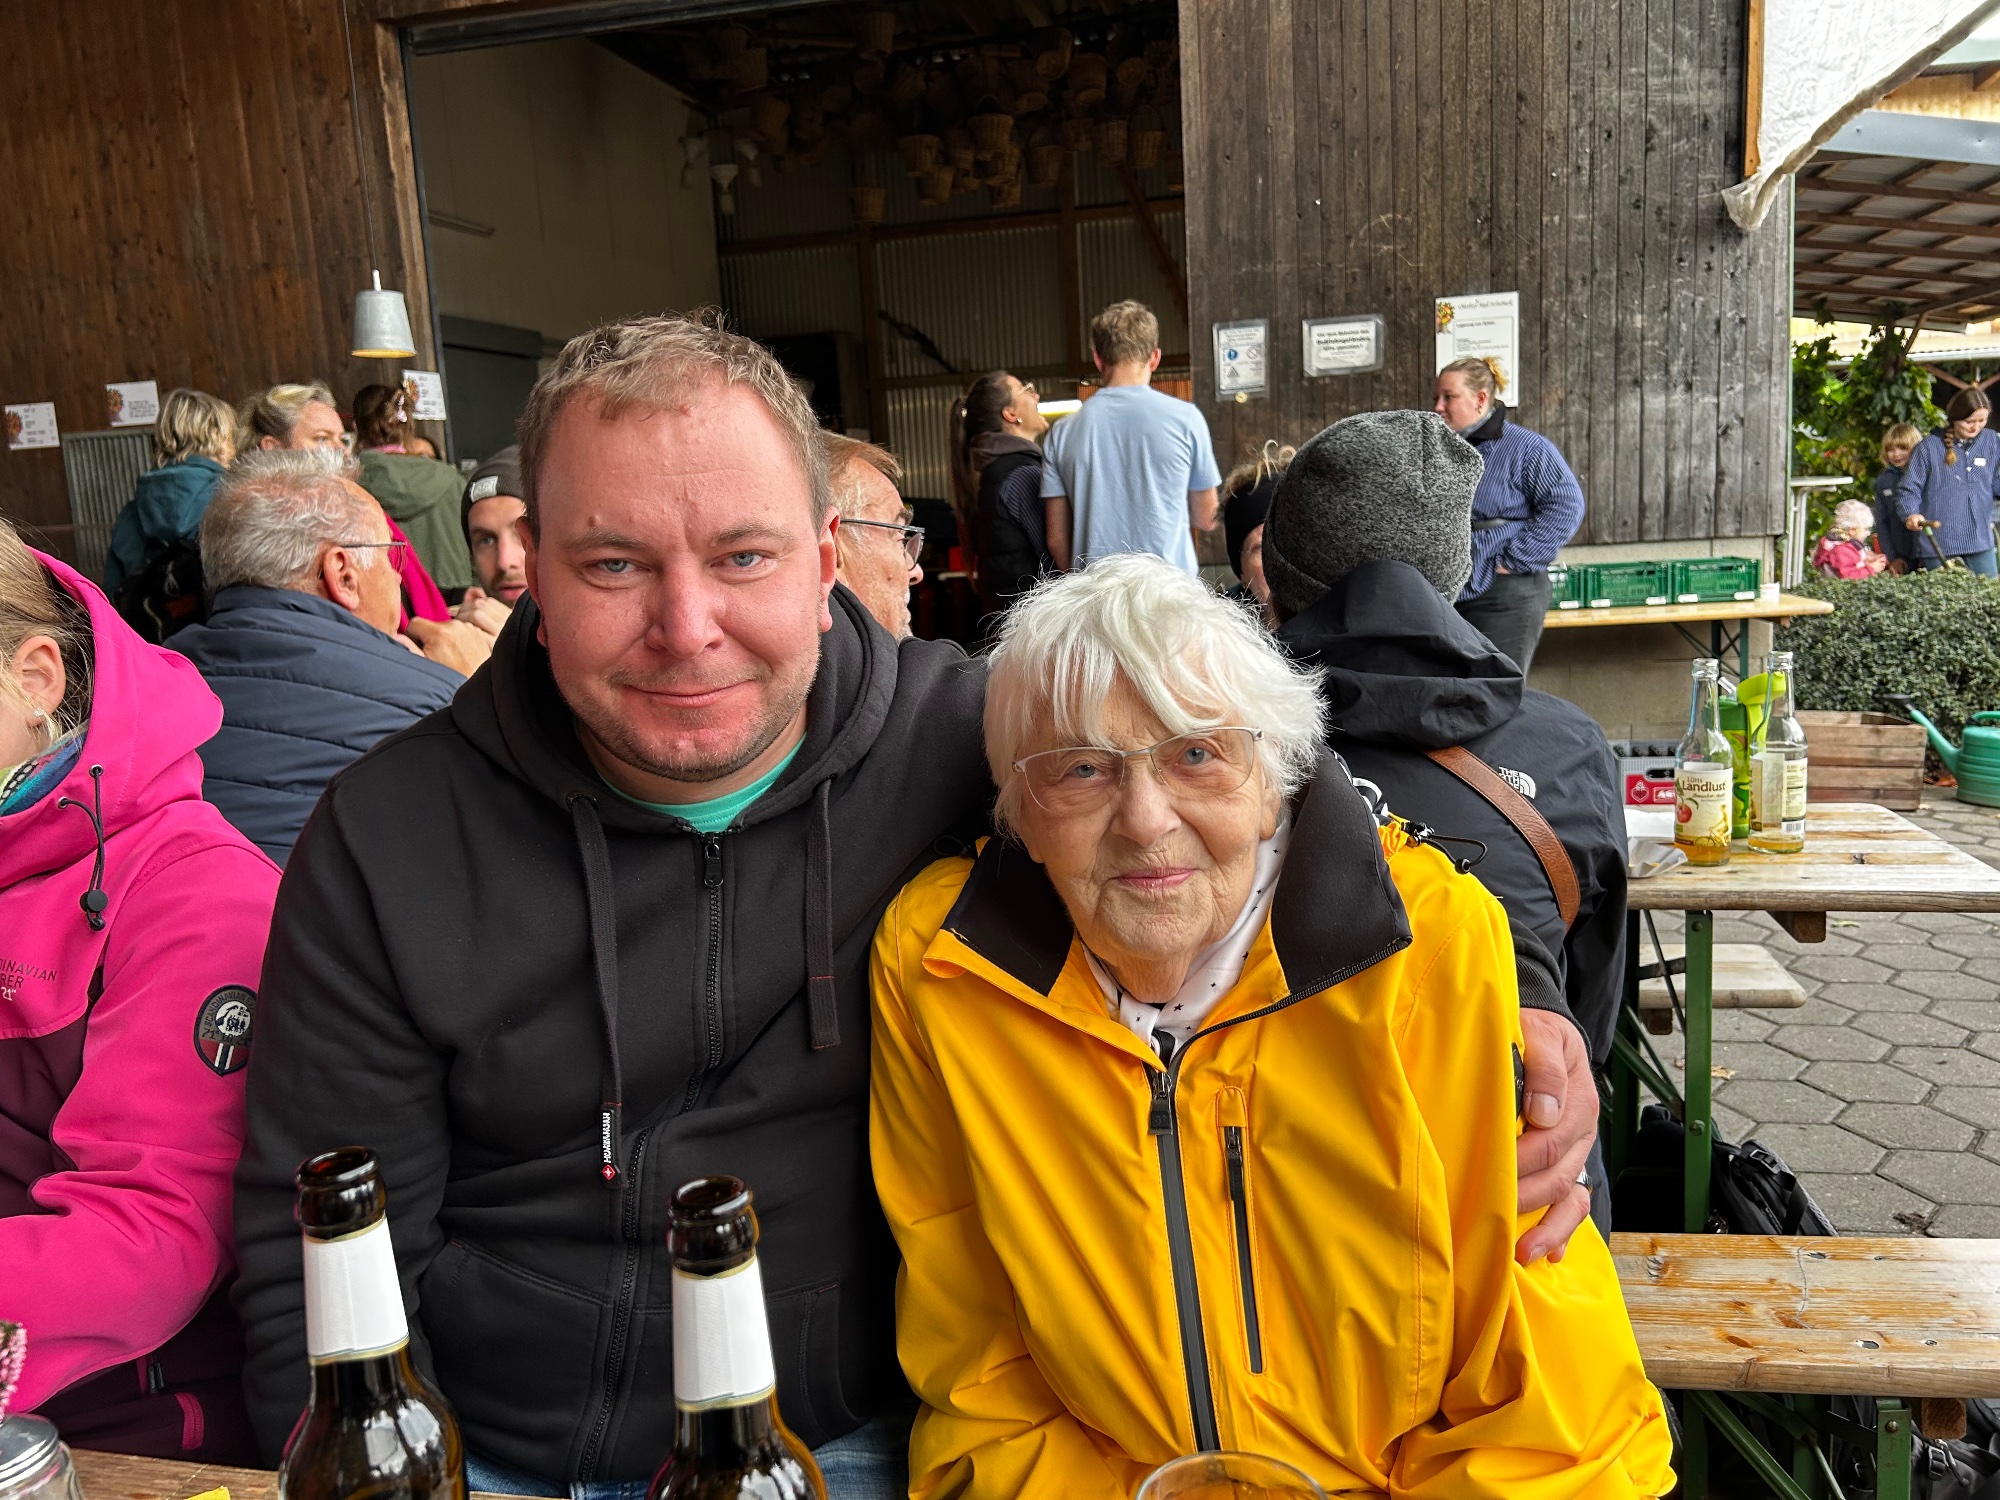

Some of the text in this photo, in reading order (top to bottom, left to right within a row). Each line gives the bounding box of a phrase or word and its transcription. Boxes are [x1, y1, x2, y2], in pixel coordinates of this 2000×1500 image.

[1498, 766, 1518, 776] THE
[1682, 780, 1726, 792] Landlust
[204, 991, 247, 1027] SCANDINAVIAN
